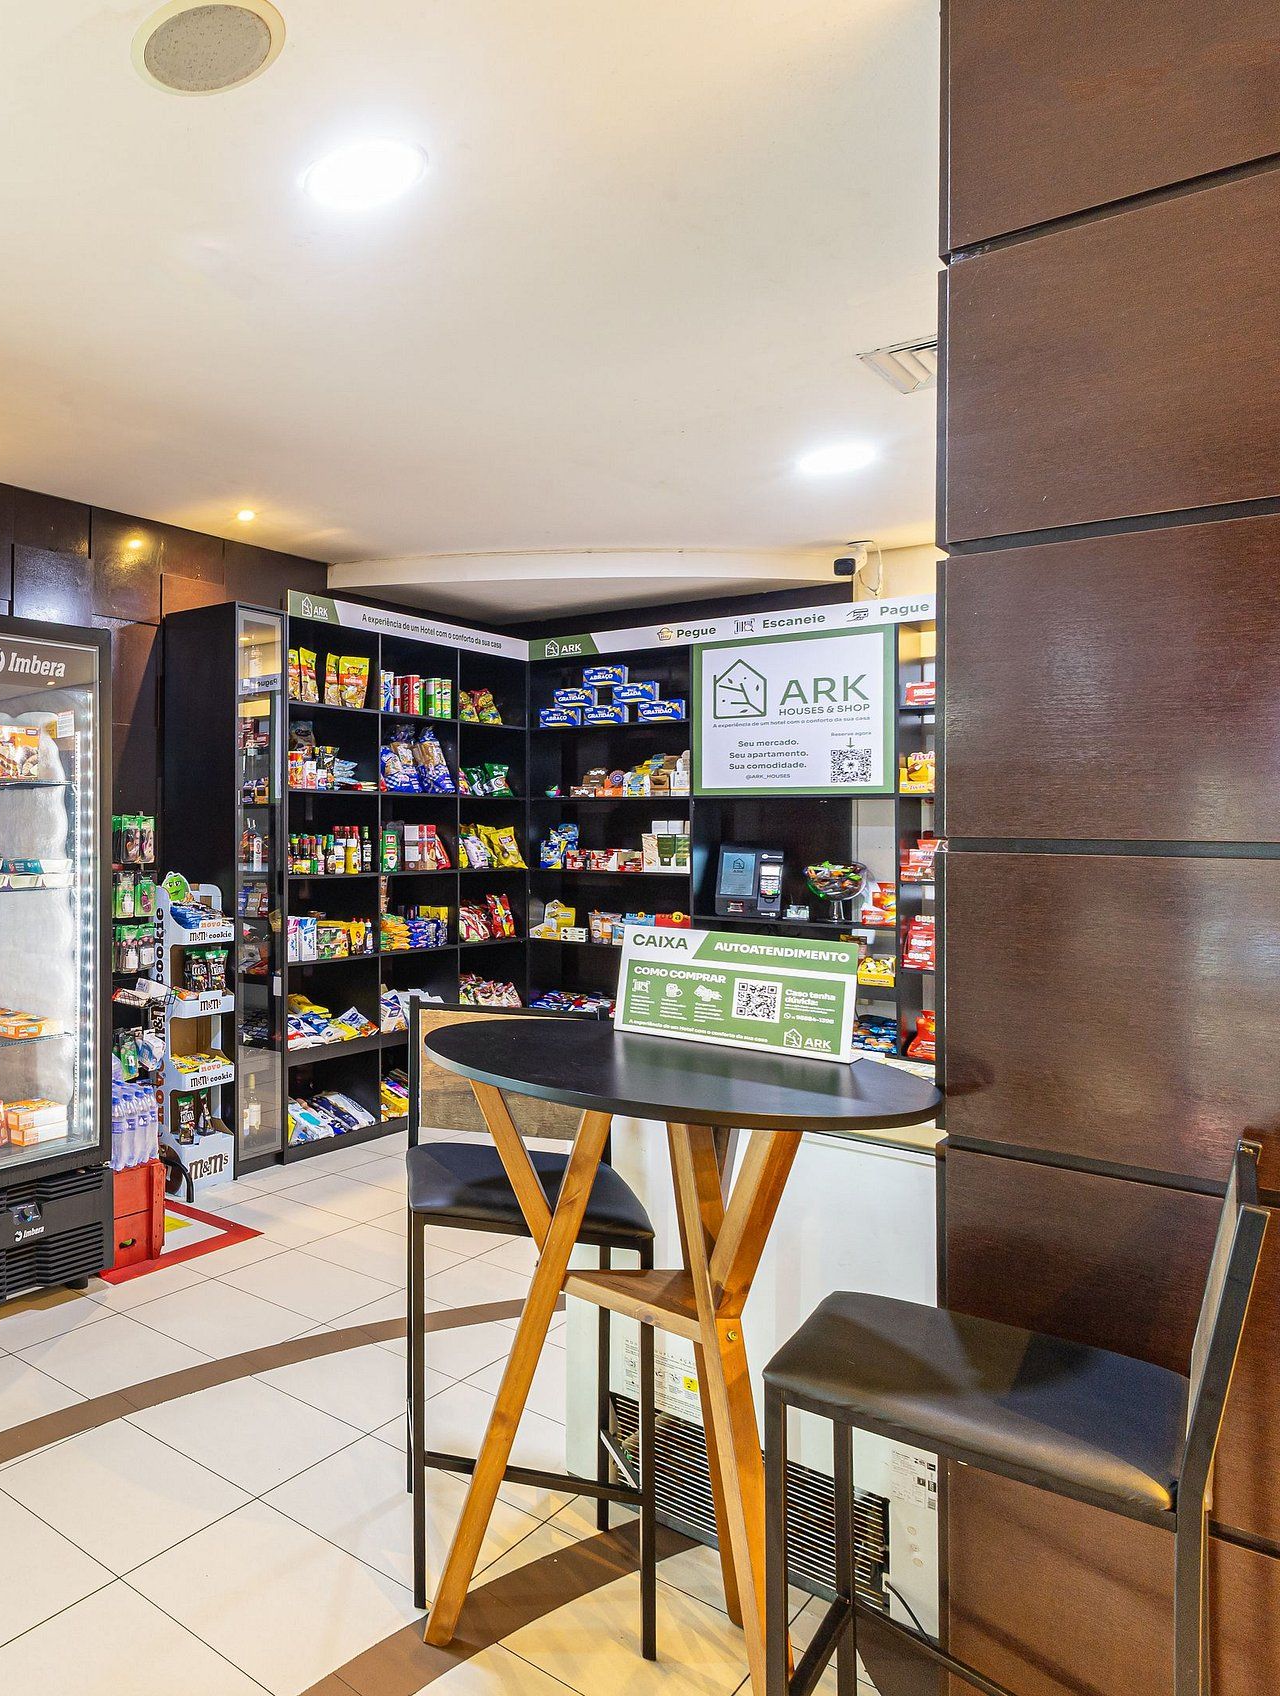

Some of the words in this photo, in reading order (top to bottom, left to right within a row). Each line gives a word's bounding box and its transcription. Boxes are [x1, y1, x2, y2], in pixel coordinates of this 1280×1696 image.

[313, 607, 328, 618] ARK
[879, 602, 929, 616] Pague
[762, 613, 825, 629] Escaneie
[362, 613, 367, 621] A
[368, 616, 402, 629] experiência
[403, 622, 410, 631] de
[420, 625, 435, 636] Hotel
[452, 632, 475, 643] conforto
[475, 636, 481, 644] da
[491, 641, 501, 649] casa
[676, 626, 716, 640] Pegue
[561, 643, 582, 654] ARK
[8, 653, 66, 677] Imbera
[780, 674, 869, 705] ARK
[779, 706, 824, 716] HOUSES
[826, 705, 834, 713] &
[837, 703, 870, 713] SHOP
[756, 739, 799, 747] mercado.
[747, 750, 808, 759] apartamento.
[746, 761, 806, 770] comodidade.
[208, 931, 232, 939] cookie
[156, 908, 164, 982] cookie
[633, 934, 688, 950] CAIXA
[714, 942, 850, 963] AUTOATENDIMENTO
[634, 966, 669, 978] COMO
[669, 969, 727, 984] COMPRAR
[785, 989, 809, 998] Caso
[809, 992, 836, 1001] tenha
[804, 1037, 831, 1049] ARK
[201, 1063, 221, 1073] novo
[210, 1071, 233, 1083] cookie
[23, 1225, 45, 1240] Imbera
